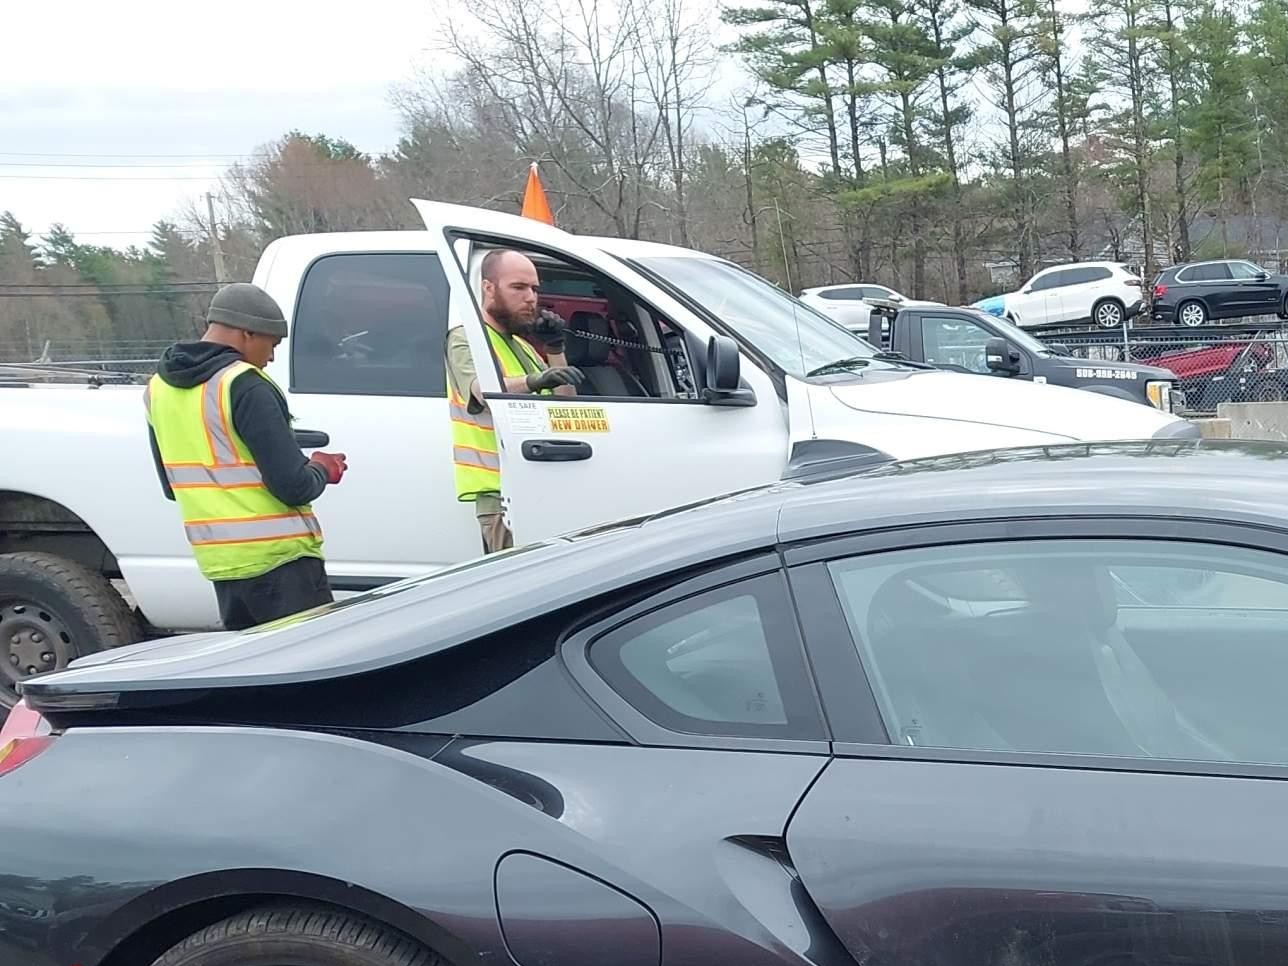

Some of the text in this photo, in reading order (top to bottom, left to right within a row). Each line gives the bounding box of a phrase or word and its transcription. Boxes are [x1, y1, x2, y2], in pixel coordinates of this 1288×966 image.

[548, 408, 604, 418] PLEASE BE PATIENT
[551, 420, 608, 430] NEW DRIVER
